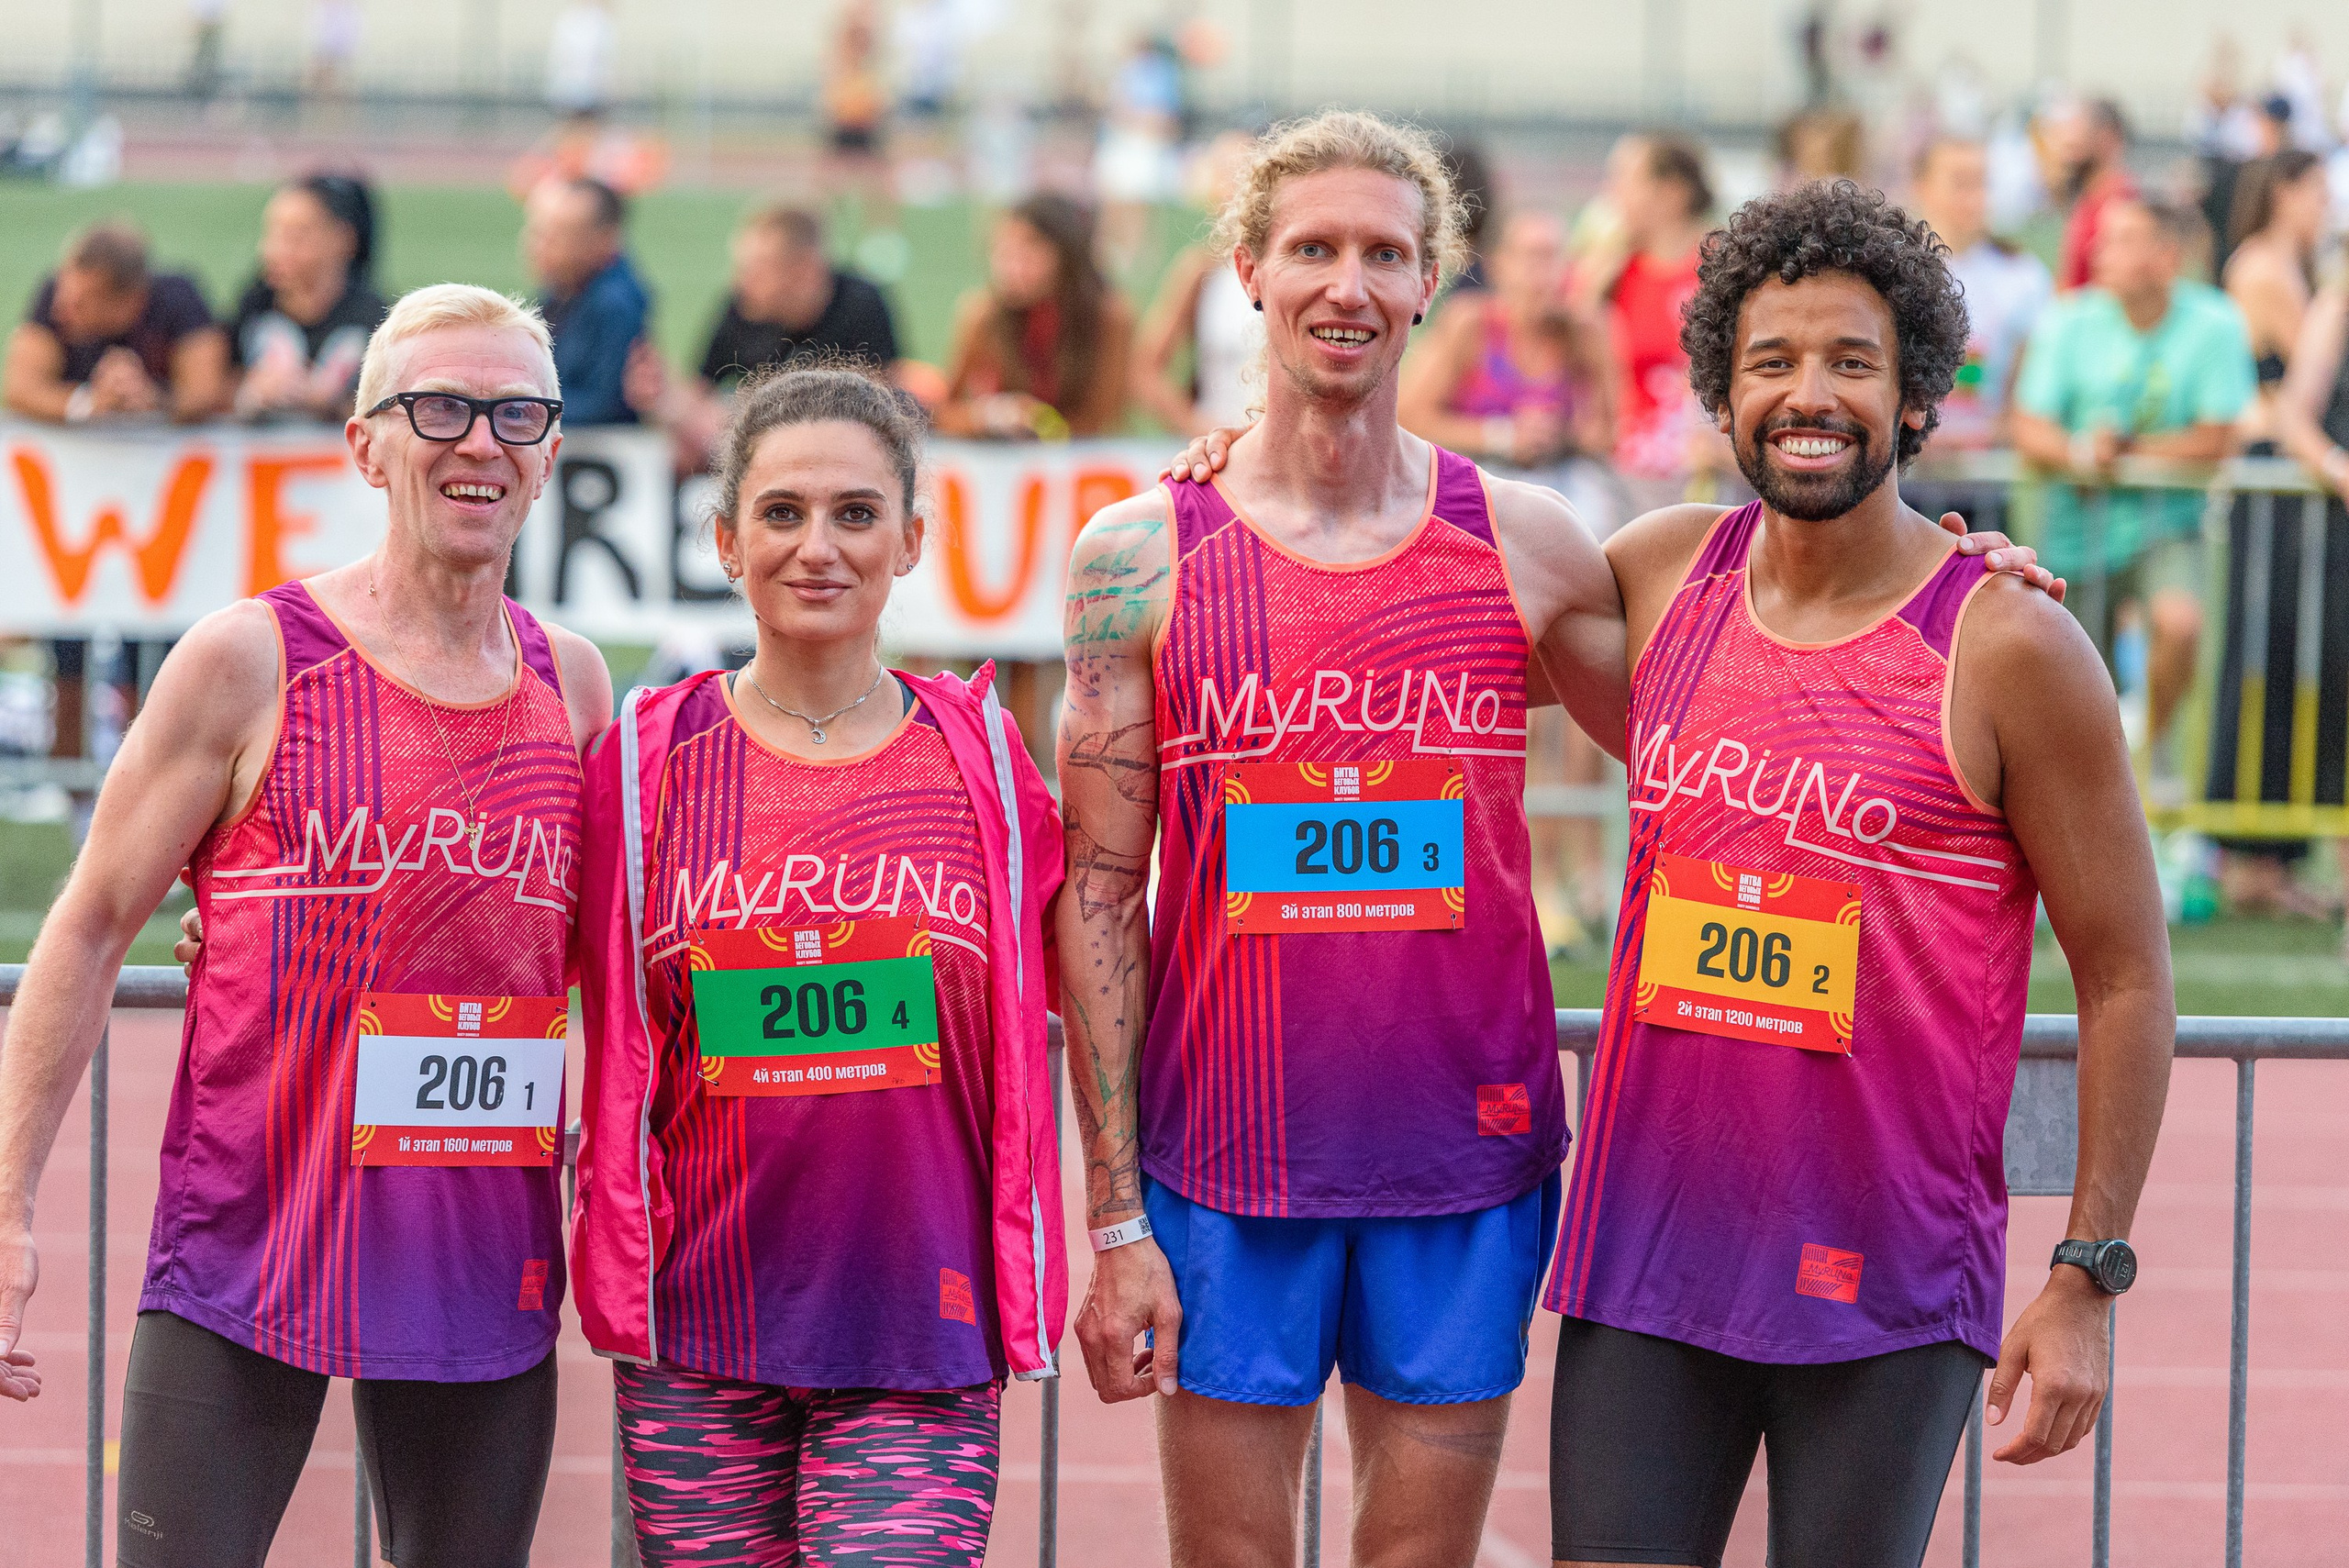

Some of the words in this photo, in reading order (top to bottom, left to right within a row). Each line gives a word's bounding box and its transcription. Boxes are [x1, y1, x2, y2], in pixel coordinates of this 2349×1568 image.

[9, 448, 349, 604] WE
[501, 457, 745, 604] RE
[1333, 767, 1360, 778] БИТВА
[1333, 777, 1360, 786] БЕГОВЫХ
[1333, 785, 1360, 795] КЛУБОВ
[1296, 817, 1400, 874] 206
[1423, 842, 1440, 872] 3
[1739, 873, 1762, 887] БИТВА
[1737, 892, 1761, 905] КЛУБОВ
[1281, 904, 1298, 918] 3й
[1301, 905, 1333, 919] этап
[1336, 904, 1362, 918] 800
[1364, 903, 1415, 919] метров
[794, 929, 821, 942] БИТВА
[796, 948, 822, 960] КЛУБОВ
[1697, 922, 1792, 988] 206
[1812, 964, 1830, 995] 2
[459, 1002, 483, 1014] БИТВА
[760, 979, 868, 1040] 206
[891, 1000, 910, 1029] 4
[1677, 1000, 1693, 1018] 2й
[1695, 1005, 1723, 1022] этап
[1725, 1008, 1753, 1028] 1200
[1755, 1015, 1804, 1035] метров
[457, 1021, 481, 1031] КЛУБОВ
[752, 1066, 770, 1084] 4й
[772, 1066, 805, 1084] этап
[807, 1064, 832, 1082] 400
[835, 1062, 887, 1082] метров
[416, 1054, 507, 1111] 206
[524, 1082, 535, 1111] 1
[397, 1136, 411, 1152] 1й
[413, 1139, 440, 1152] этап
[442, 1138, 469, 1152] 1600
[471, 1139, 513, 1154] метров
[1102, 1229, 1125, 1245] 231
